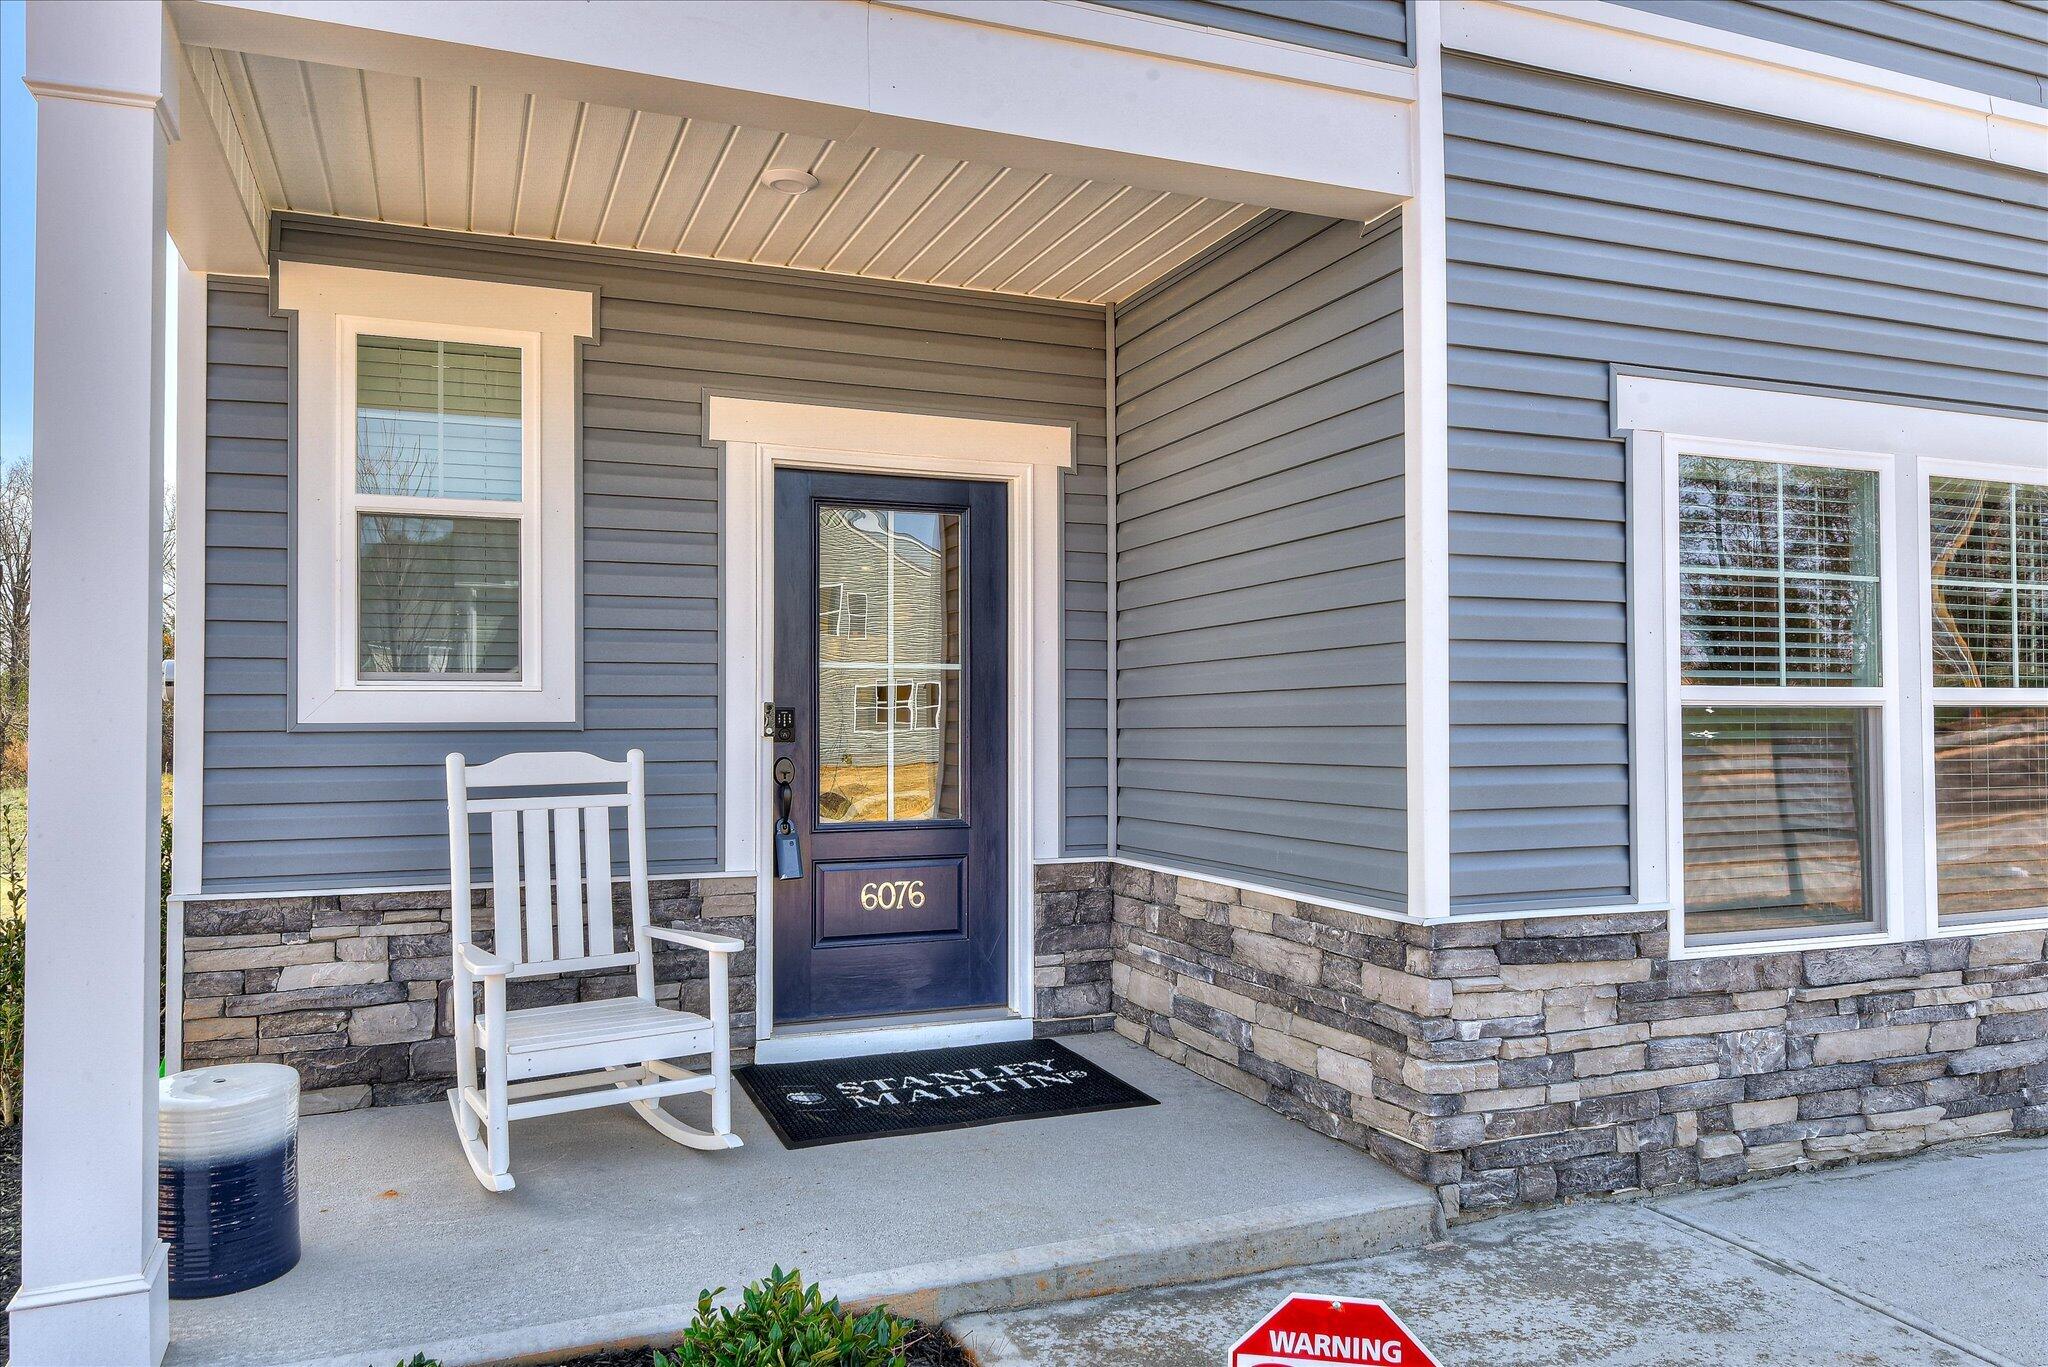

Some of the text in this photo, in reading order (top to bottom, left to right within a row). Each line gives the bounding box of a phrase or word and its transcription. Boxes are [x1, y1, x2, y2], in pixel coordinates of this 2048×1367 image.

[861, 881, 925, 910] 6076
[836, 1058, 1056, 1095] STANLEY
[1269, 1330, 1401, 1363] WARNING
